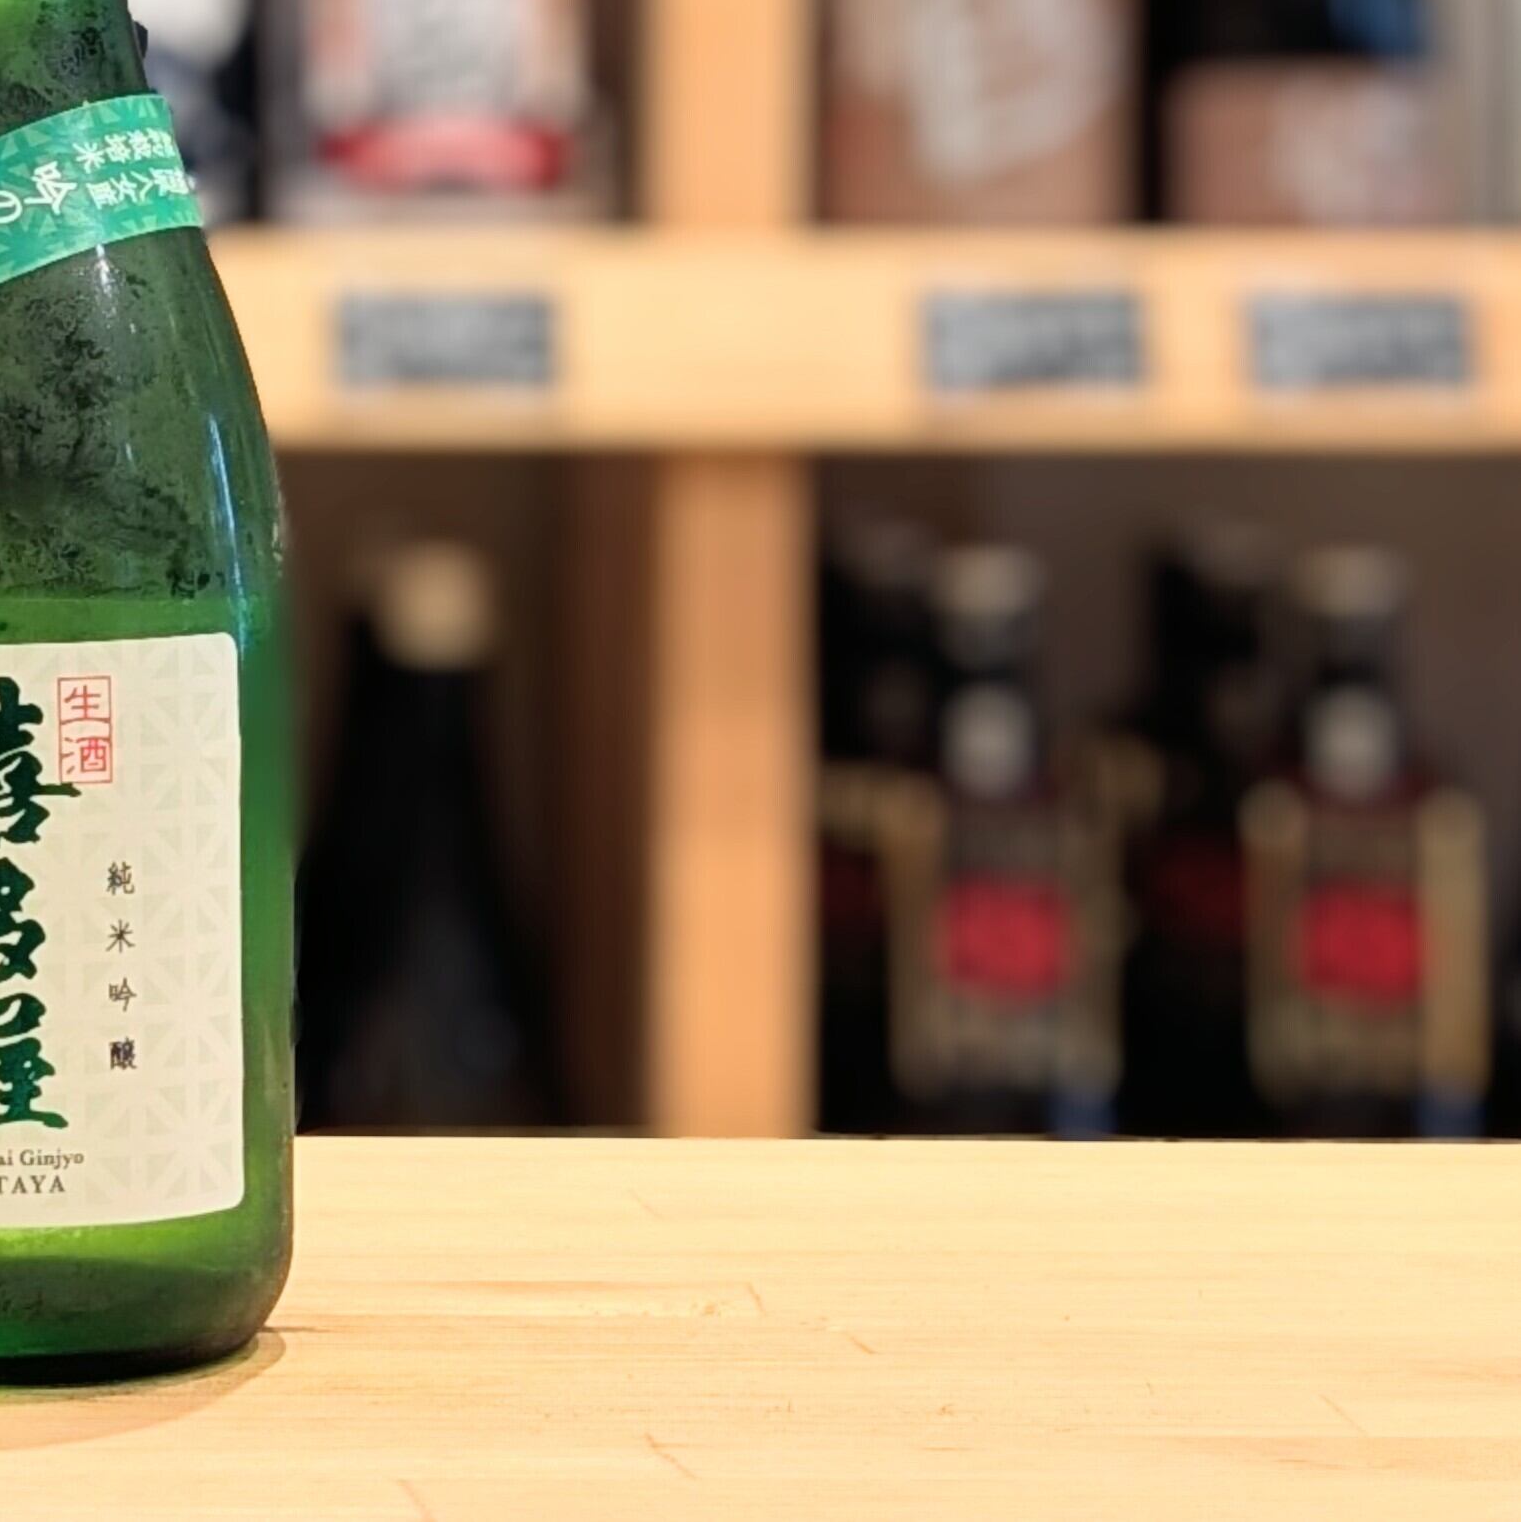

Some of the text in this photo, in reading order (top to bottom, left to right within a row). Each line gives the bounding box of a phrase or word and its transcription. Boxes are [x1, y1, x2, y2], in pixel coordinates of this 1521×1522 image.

[59, 681, 112, 781] 生酒
[105, 860, 138, 1072] 純米吟醸
[19, 1148, 85, 1169] Ginjyo
